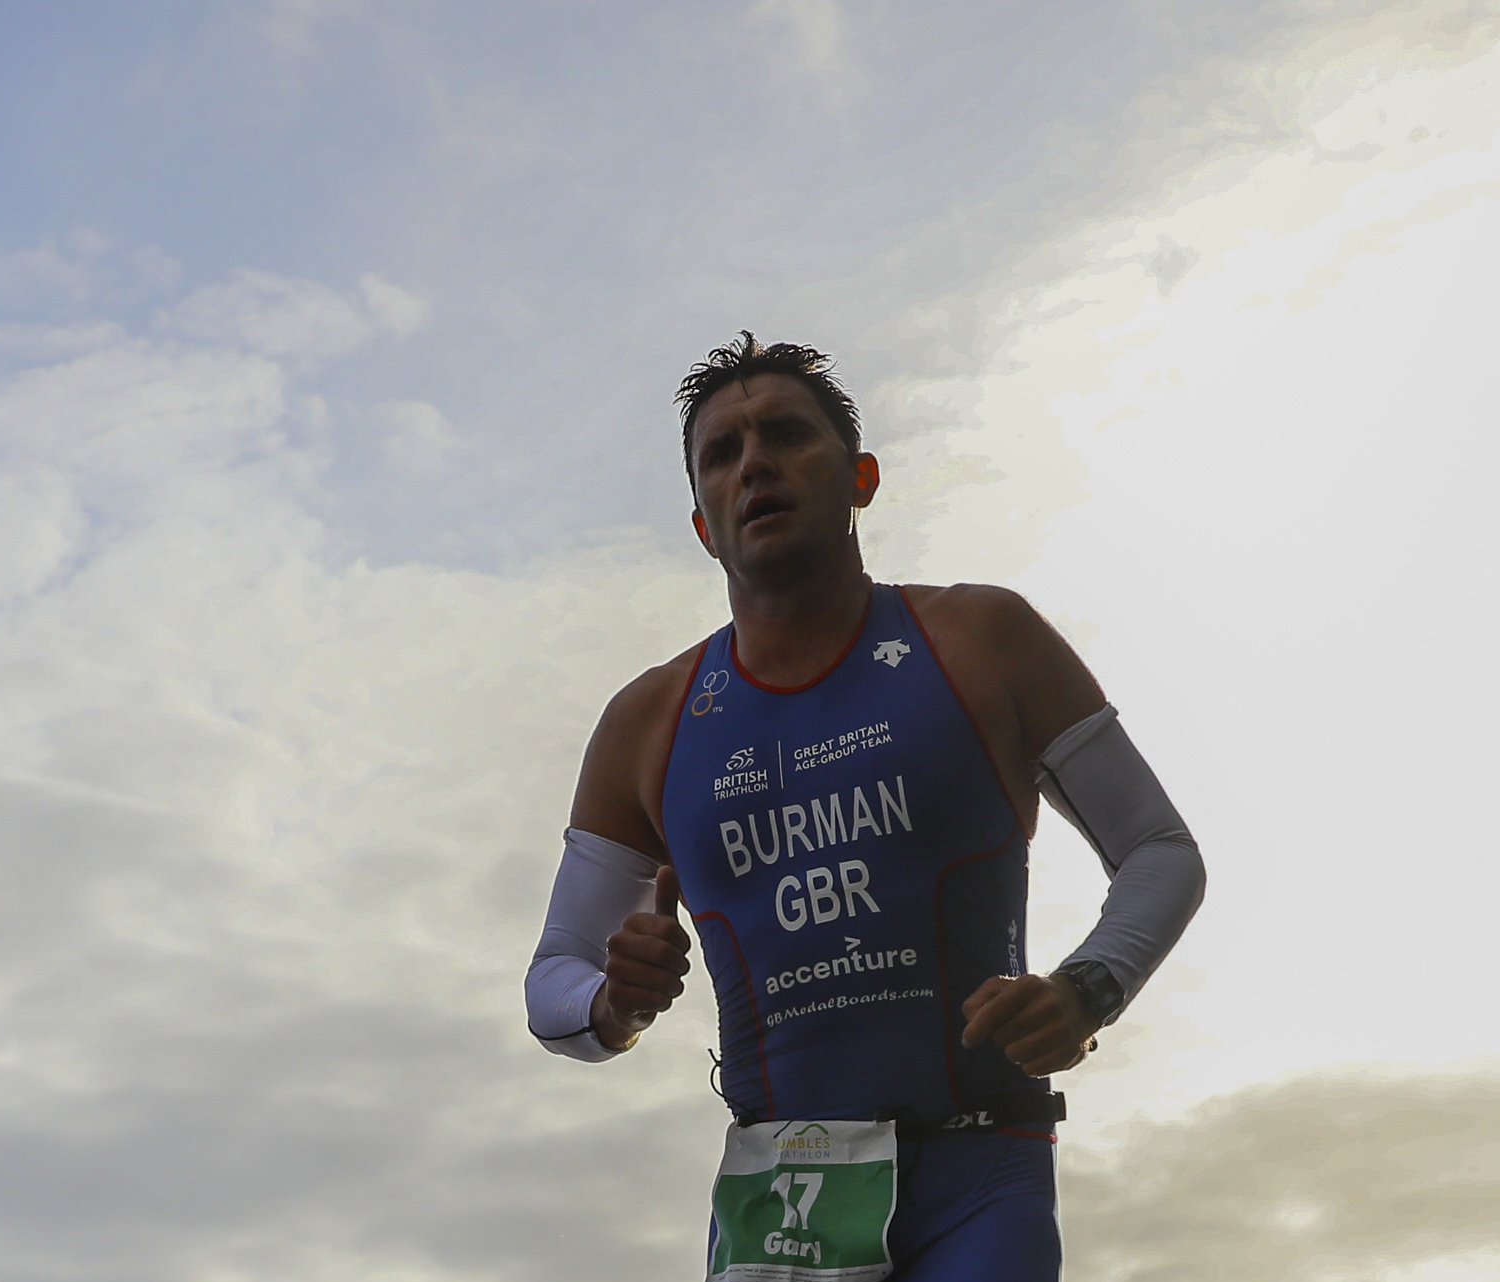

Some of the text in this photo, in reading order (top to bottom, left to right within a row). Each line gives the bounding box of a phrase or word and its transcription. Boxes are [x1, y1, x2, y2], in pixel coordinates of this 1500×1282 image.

[793, 721, 890, 760] GREAT BRITAIN
[795, 733, 892, 772] AGE-GROUP TEAM
[714, 769, 767, 791] BRITISH
[714, 782, 769, 801] TRIATHLON
[719, 775, 913, 878] BURMAN
[775, 859, 881, 932] GBR
[765, 949, 917, 995] accenture
[767, 988, 934, 1028] GBMedalBoards.com
[770, 1172, 824, 1230] 17
[763, 1231, 822, 1265] Gary
